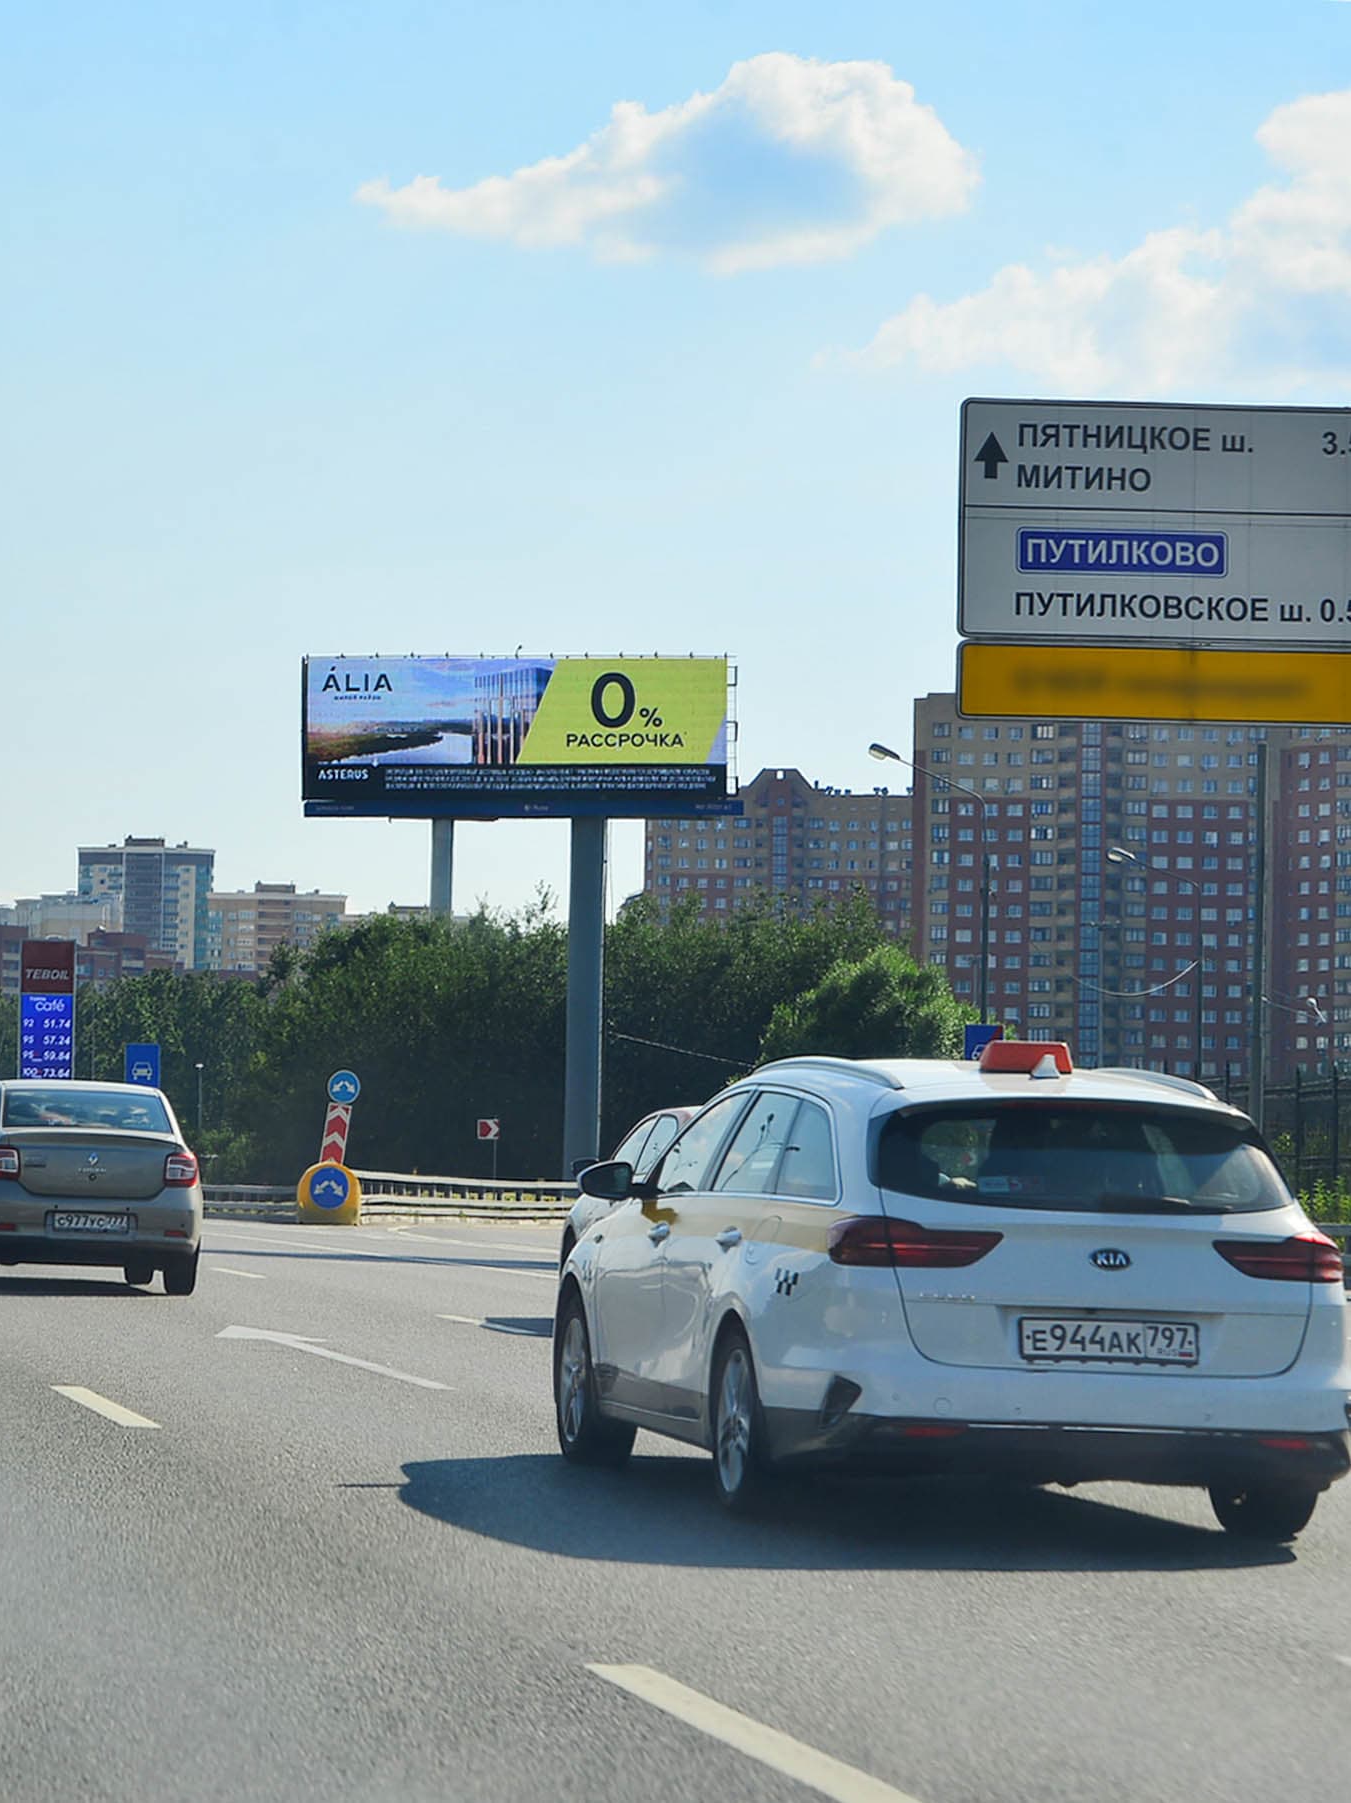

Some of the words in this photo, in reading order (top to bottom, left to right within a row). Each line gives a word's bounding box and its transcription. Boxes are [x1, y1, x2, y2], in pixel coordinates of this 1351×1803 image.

[1018, 423, 1211, 453] ПЯТНИЦКОЕ
[1222, 435, 1254, 453] ш.
[1322, 431, 1351, 455] 3.
[1017, 464, 1151, 492] МИТИНО
[1026, 538, 1220, 568] ПУТИЛКОВО
[1015, 592, 1269, 622] ПУТИЛКОВСКОЕ
[1280, 604, 1311, 622] ш.
[1320, 598, 1351, 623] 0.
[322, 666, 393, 692] ÁLIA
[318, 769, 369, 780] ASTERUS
[25, 968, 69, 980] TEBOIL
[1097, 1253, 1127, 1266] KIA
